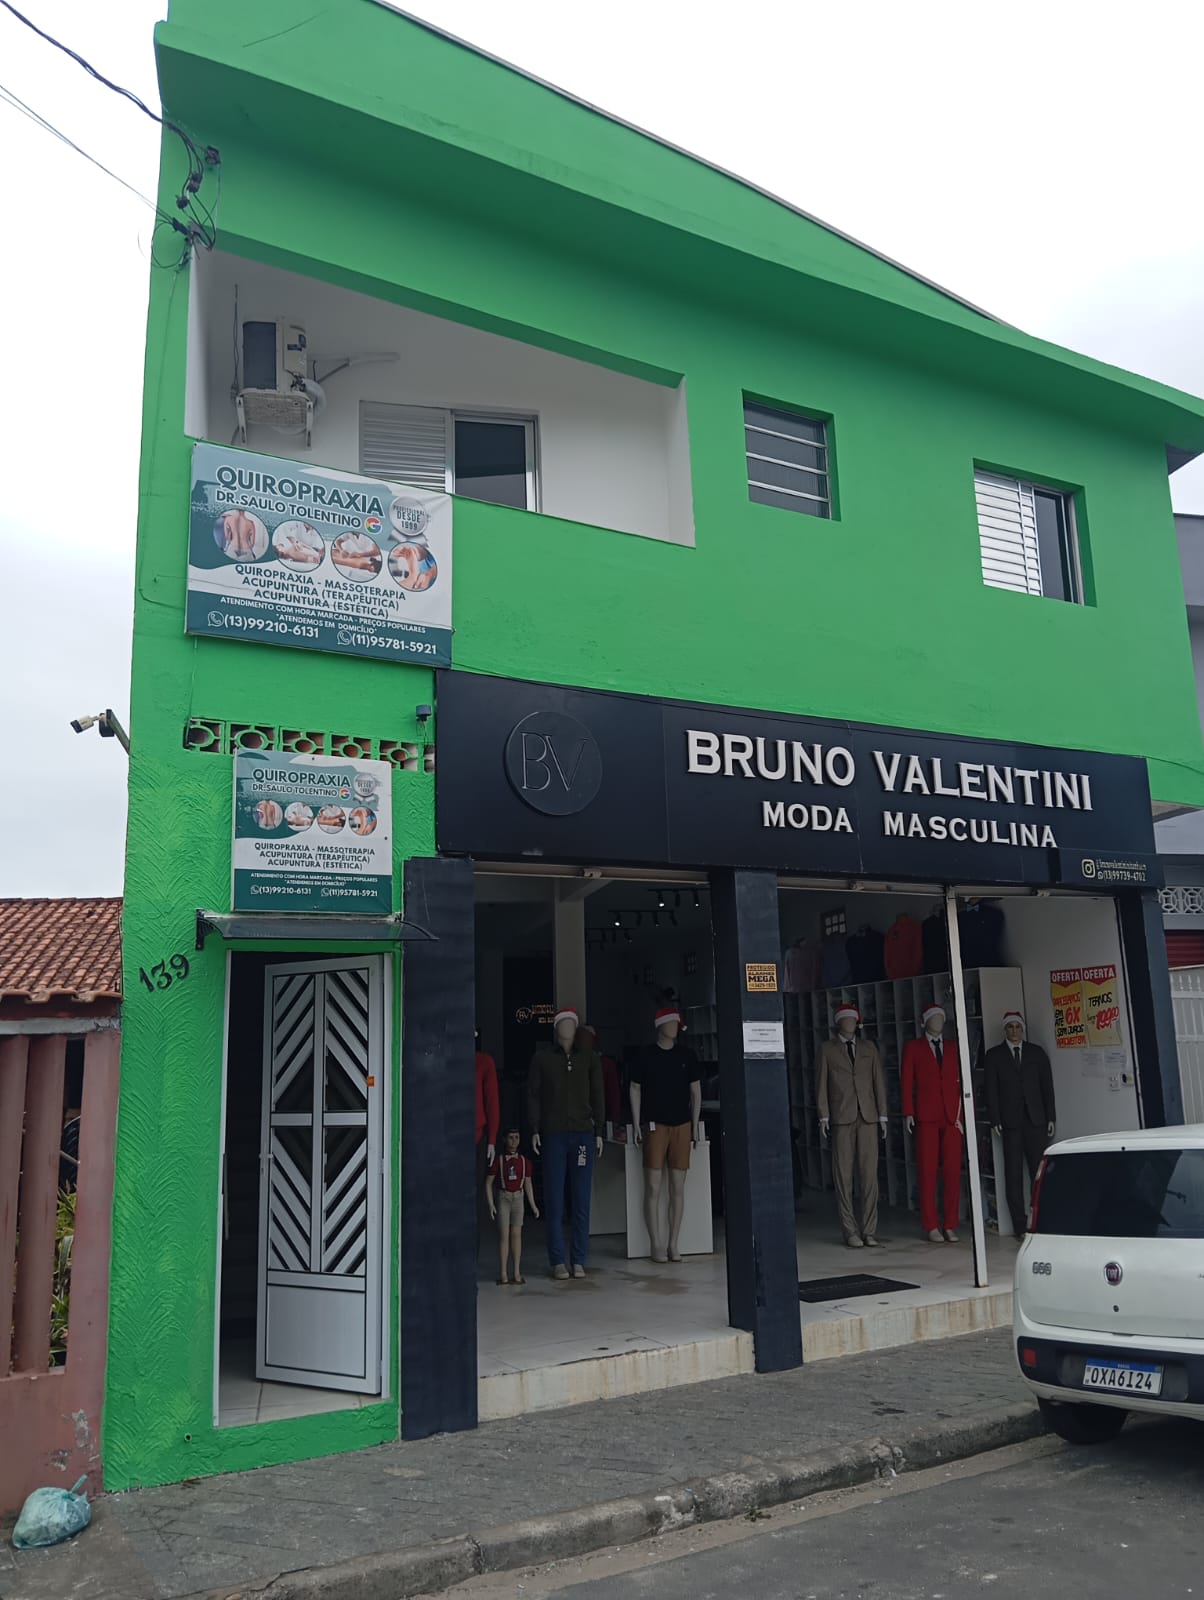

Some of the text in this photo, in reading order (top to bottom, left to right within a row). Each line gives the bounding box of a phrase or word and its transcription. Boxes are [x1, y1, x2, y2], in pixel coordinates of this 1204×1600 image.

[216, 466, 384, 517] QUIROPRAXIA
[216, 490, 361, 528] DR.SAULO TOLENTINO
[396, 511, 421, 523] DESDE
[235, 564, 314, 585] QUIROPRAXIA
[324, 579, 406, 600] MASSOTERAPIA
[242, 576, 400, 611] ACUPUNTURA (TERAPÊUTICA)
[254, 589, 389, 619] ACUPUNTURA (ESTÉTICA)
[220, 596, 274, 610] ATENDIMENTO
[275, 604, 294, 613] COM
[295, 607, 316, 617] HORA
[317, 610, 354, 623] MARCADA
[359, 617, 386, 628] PREÇOS
[387, 621, 426, 634] POPULARES
[324, 621, 335, 629] EM
[224, 613, 319, 639] (13)99210-6131
[352, 633, 437, 654] (11)95781-5921
[520, 731, 589, 792] BV
[686, 729, 1094, 811] BRUNO VALENTINI
[253, 768, 351, 788] QUIROPRAXIA
[294, 786, 338, 797] TOLENTINO
[762, 800, 1058, 848] MODA MASCULINA
[254, 842, 310, 852] QUIROPRAXIA
[317, 846, 375, 856] MASSOTERAPIA
[259, 851, 313, 860] ACUPUNTURA
[267, 859, 321, 868] ACUPUNTURA
[139, 953, 190, 993] 139
[748, 975, 775, 983] MEGA
[1052, 971, 1081, 982] OFERTA
[1083, 967, 1115, 980] OFERTA
[1065, 1006, 1081, 1025] 6X
